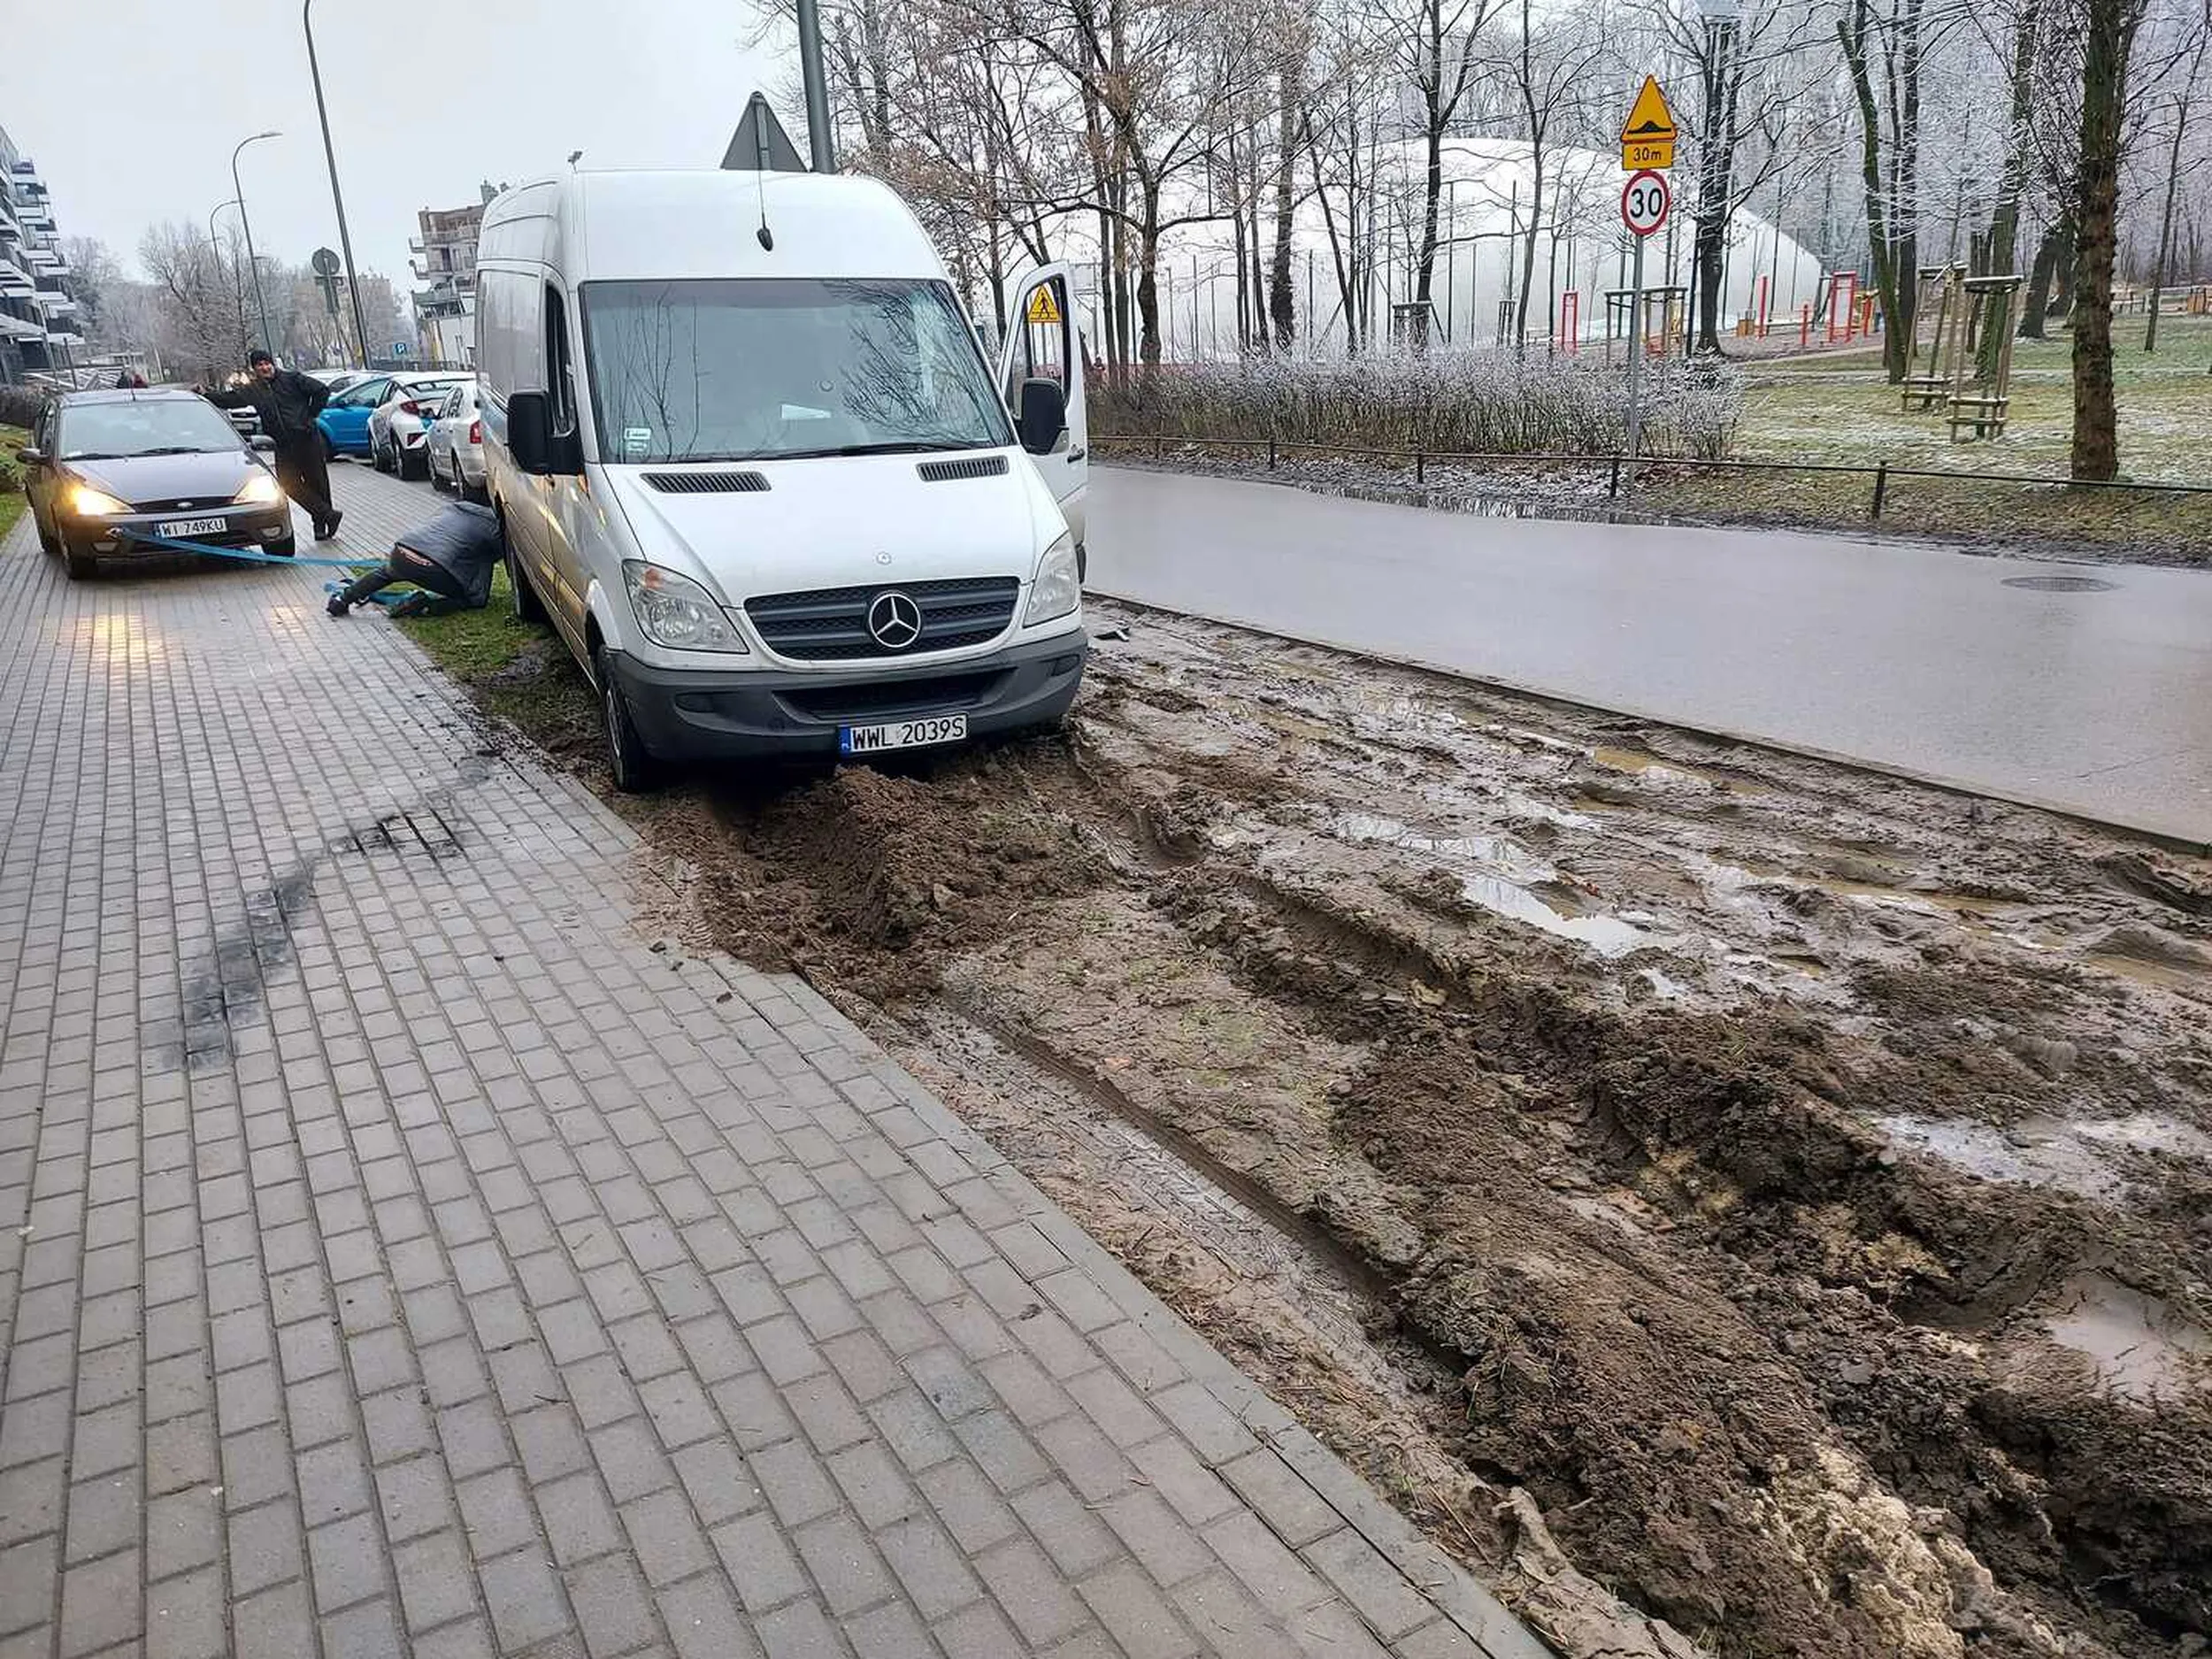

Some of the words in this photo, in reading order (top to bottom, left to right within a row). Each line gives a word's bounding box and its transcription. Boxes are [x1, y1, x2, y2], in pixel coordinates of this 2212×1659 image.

[1633, 147, 1662, 161] 30m
[1630, 188, 1663, 219] 30
[184, 518, 225, 534] 749KU
[852, 726, 894, 750] WWL
[902, 717, 964, 745] 2039S
